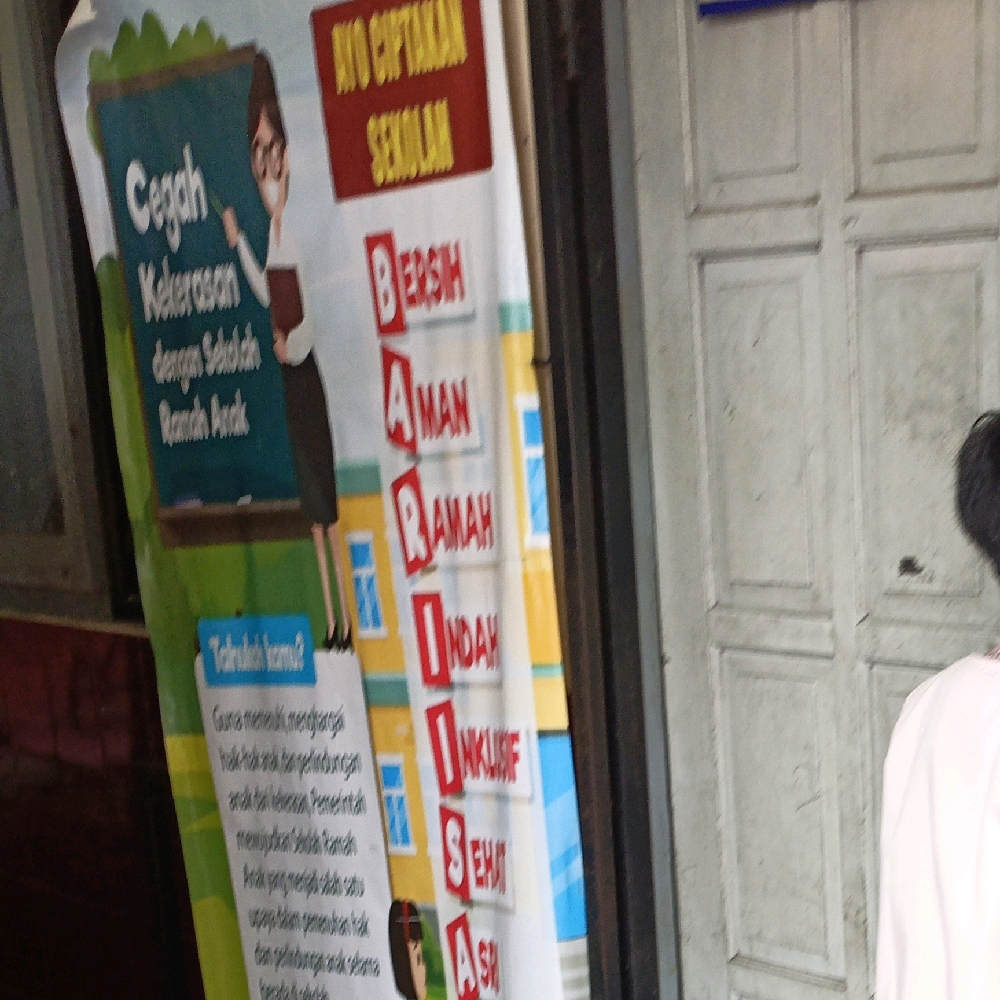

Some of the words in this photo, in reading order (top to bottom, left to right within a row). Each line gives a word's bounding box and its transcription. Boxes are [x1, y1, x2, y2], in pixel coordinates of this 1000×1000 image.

[126, 142, 208, 253] Cegah
[138, 255, 241, 323] Kekerasan
[372, 238, 466, 327] BERSIH
[152, 338, 204, 395] dengan
[202, 322, 261, 376] Sekolah
[159, 394, 209, 447] Ramah
[210, 388, 249, 438] Anak
[387, 360, 471, 443] AMAN
[397, 485, 494, 562] RAMAH
[422, 601, 499, 676] INDAH
